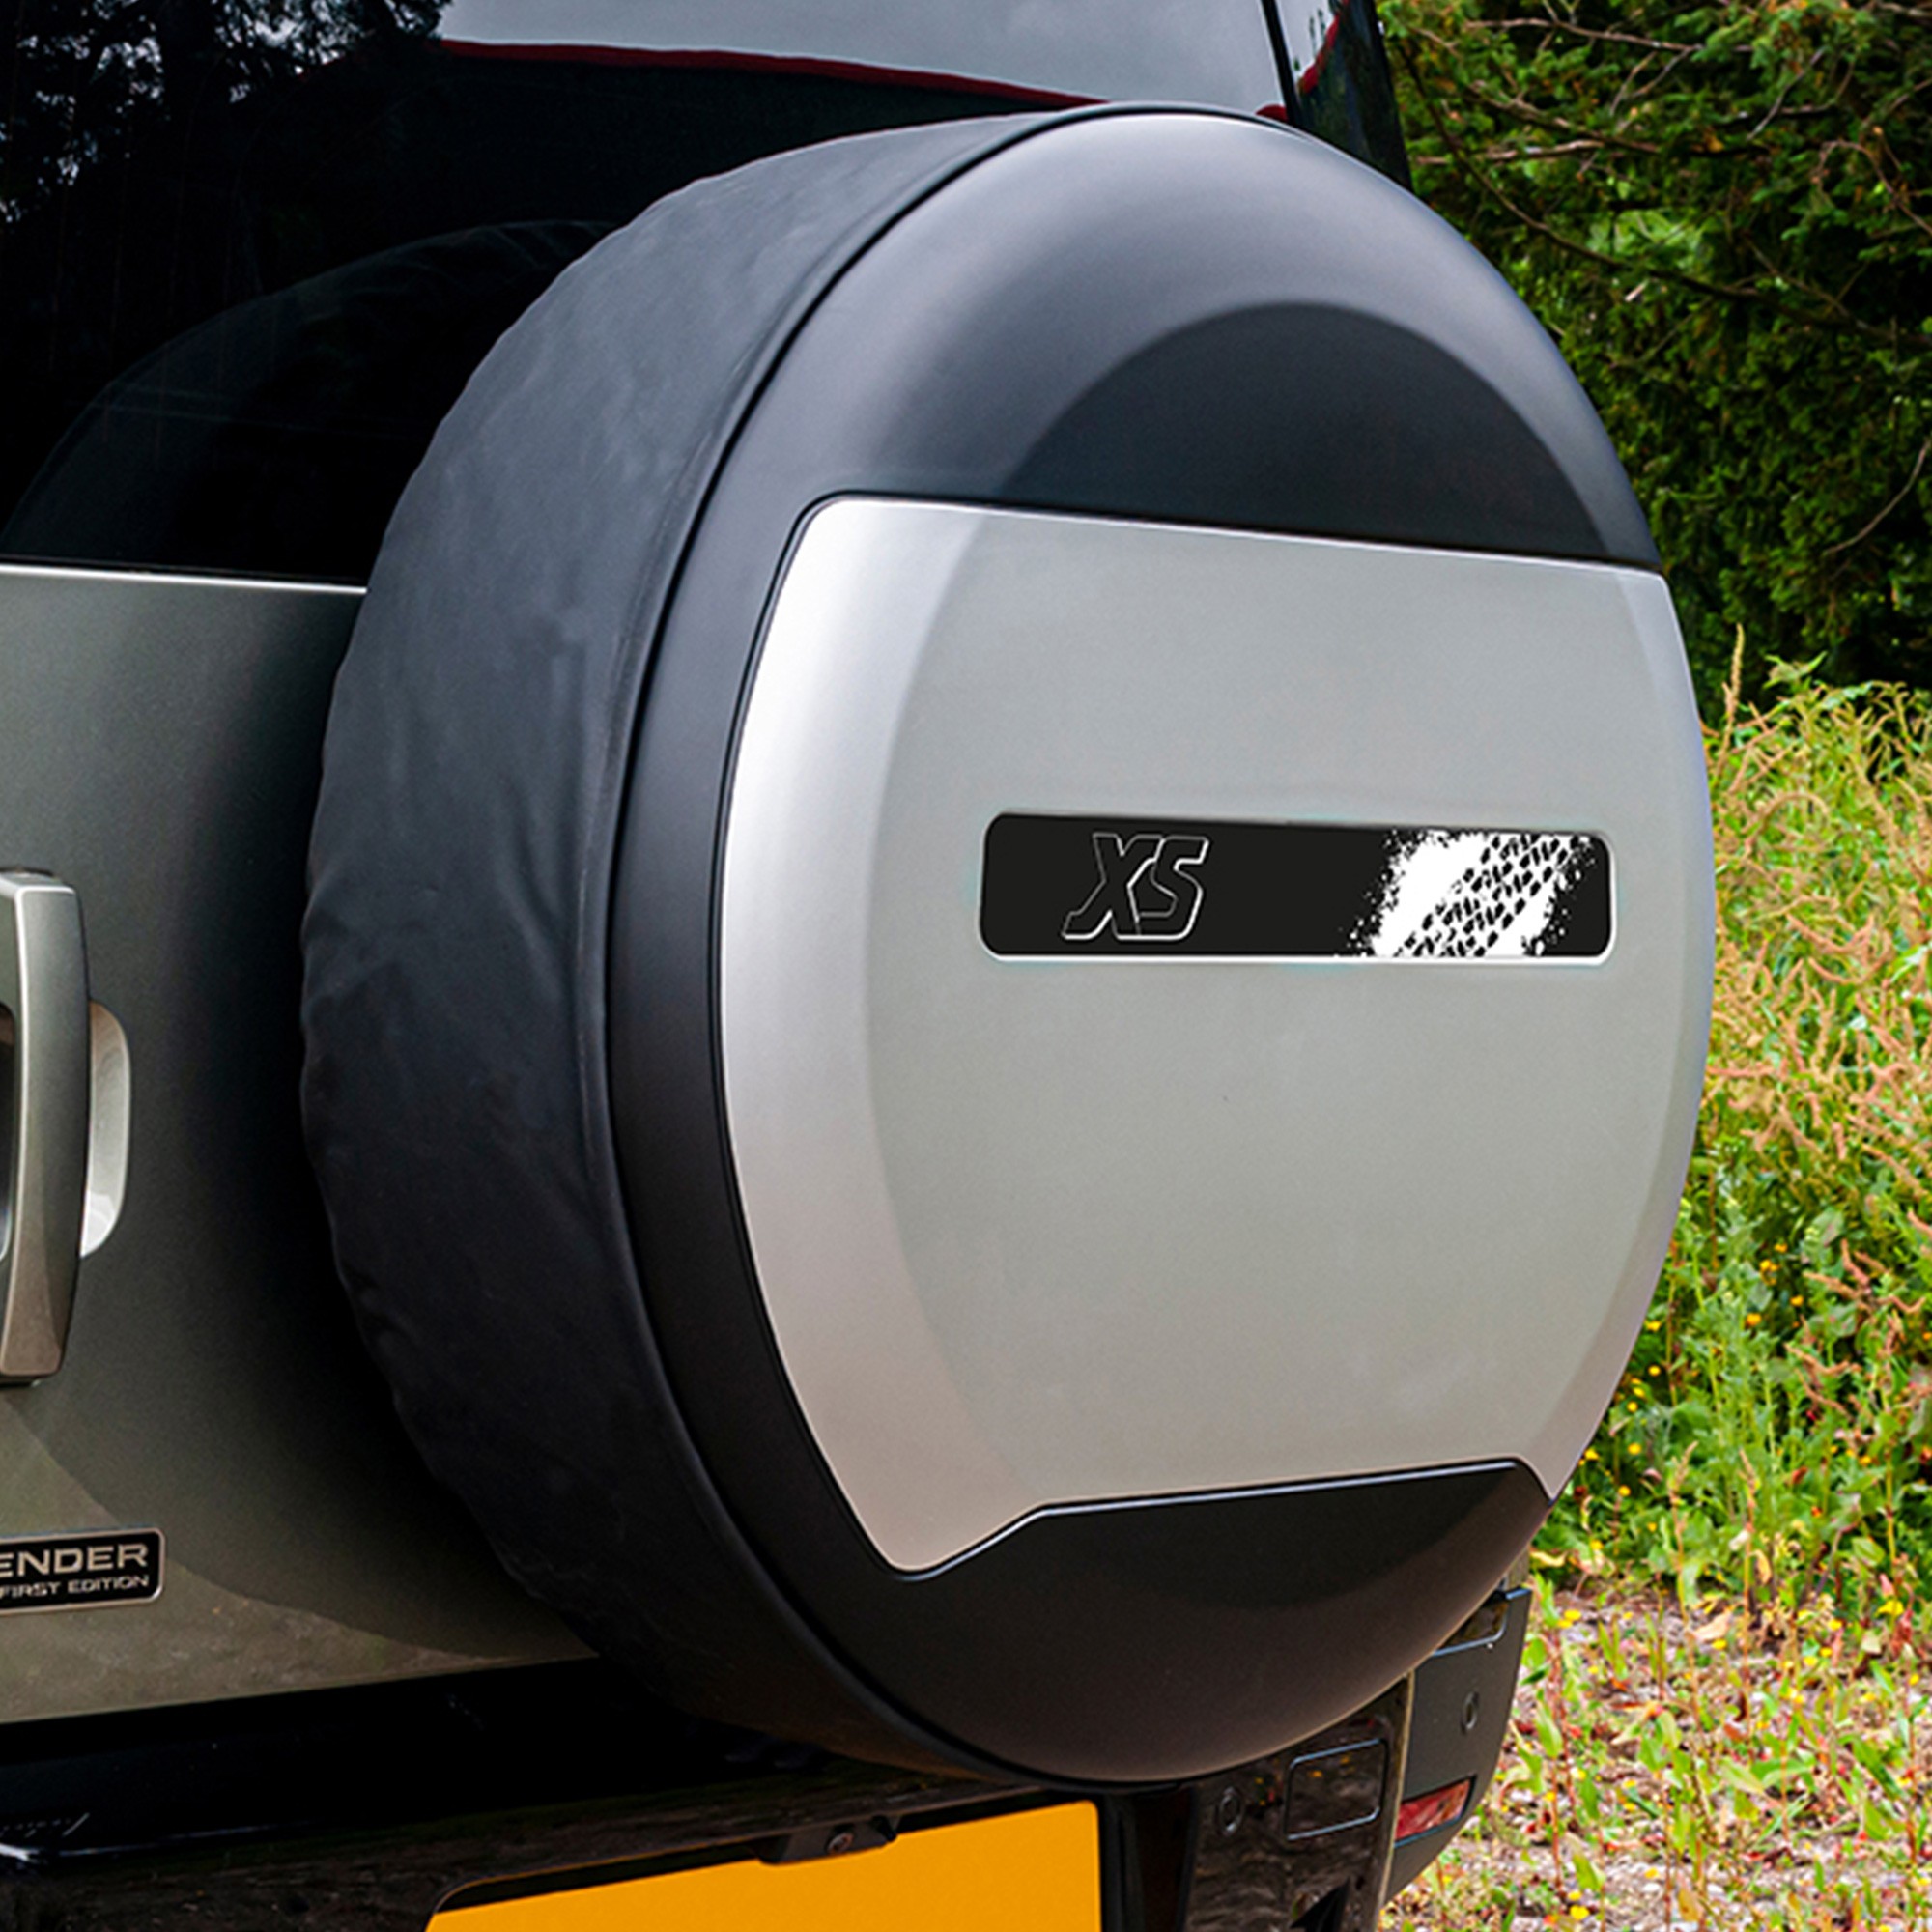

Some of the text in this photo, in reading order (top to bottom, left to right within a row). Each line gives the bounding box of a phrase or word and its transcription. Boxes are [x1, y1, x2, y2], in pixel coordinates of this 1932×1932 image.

[1063, 832, 1209, 940] XS
[0, 1575, 150, 1599] FIRST EDITION
